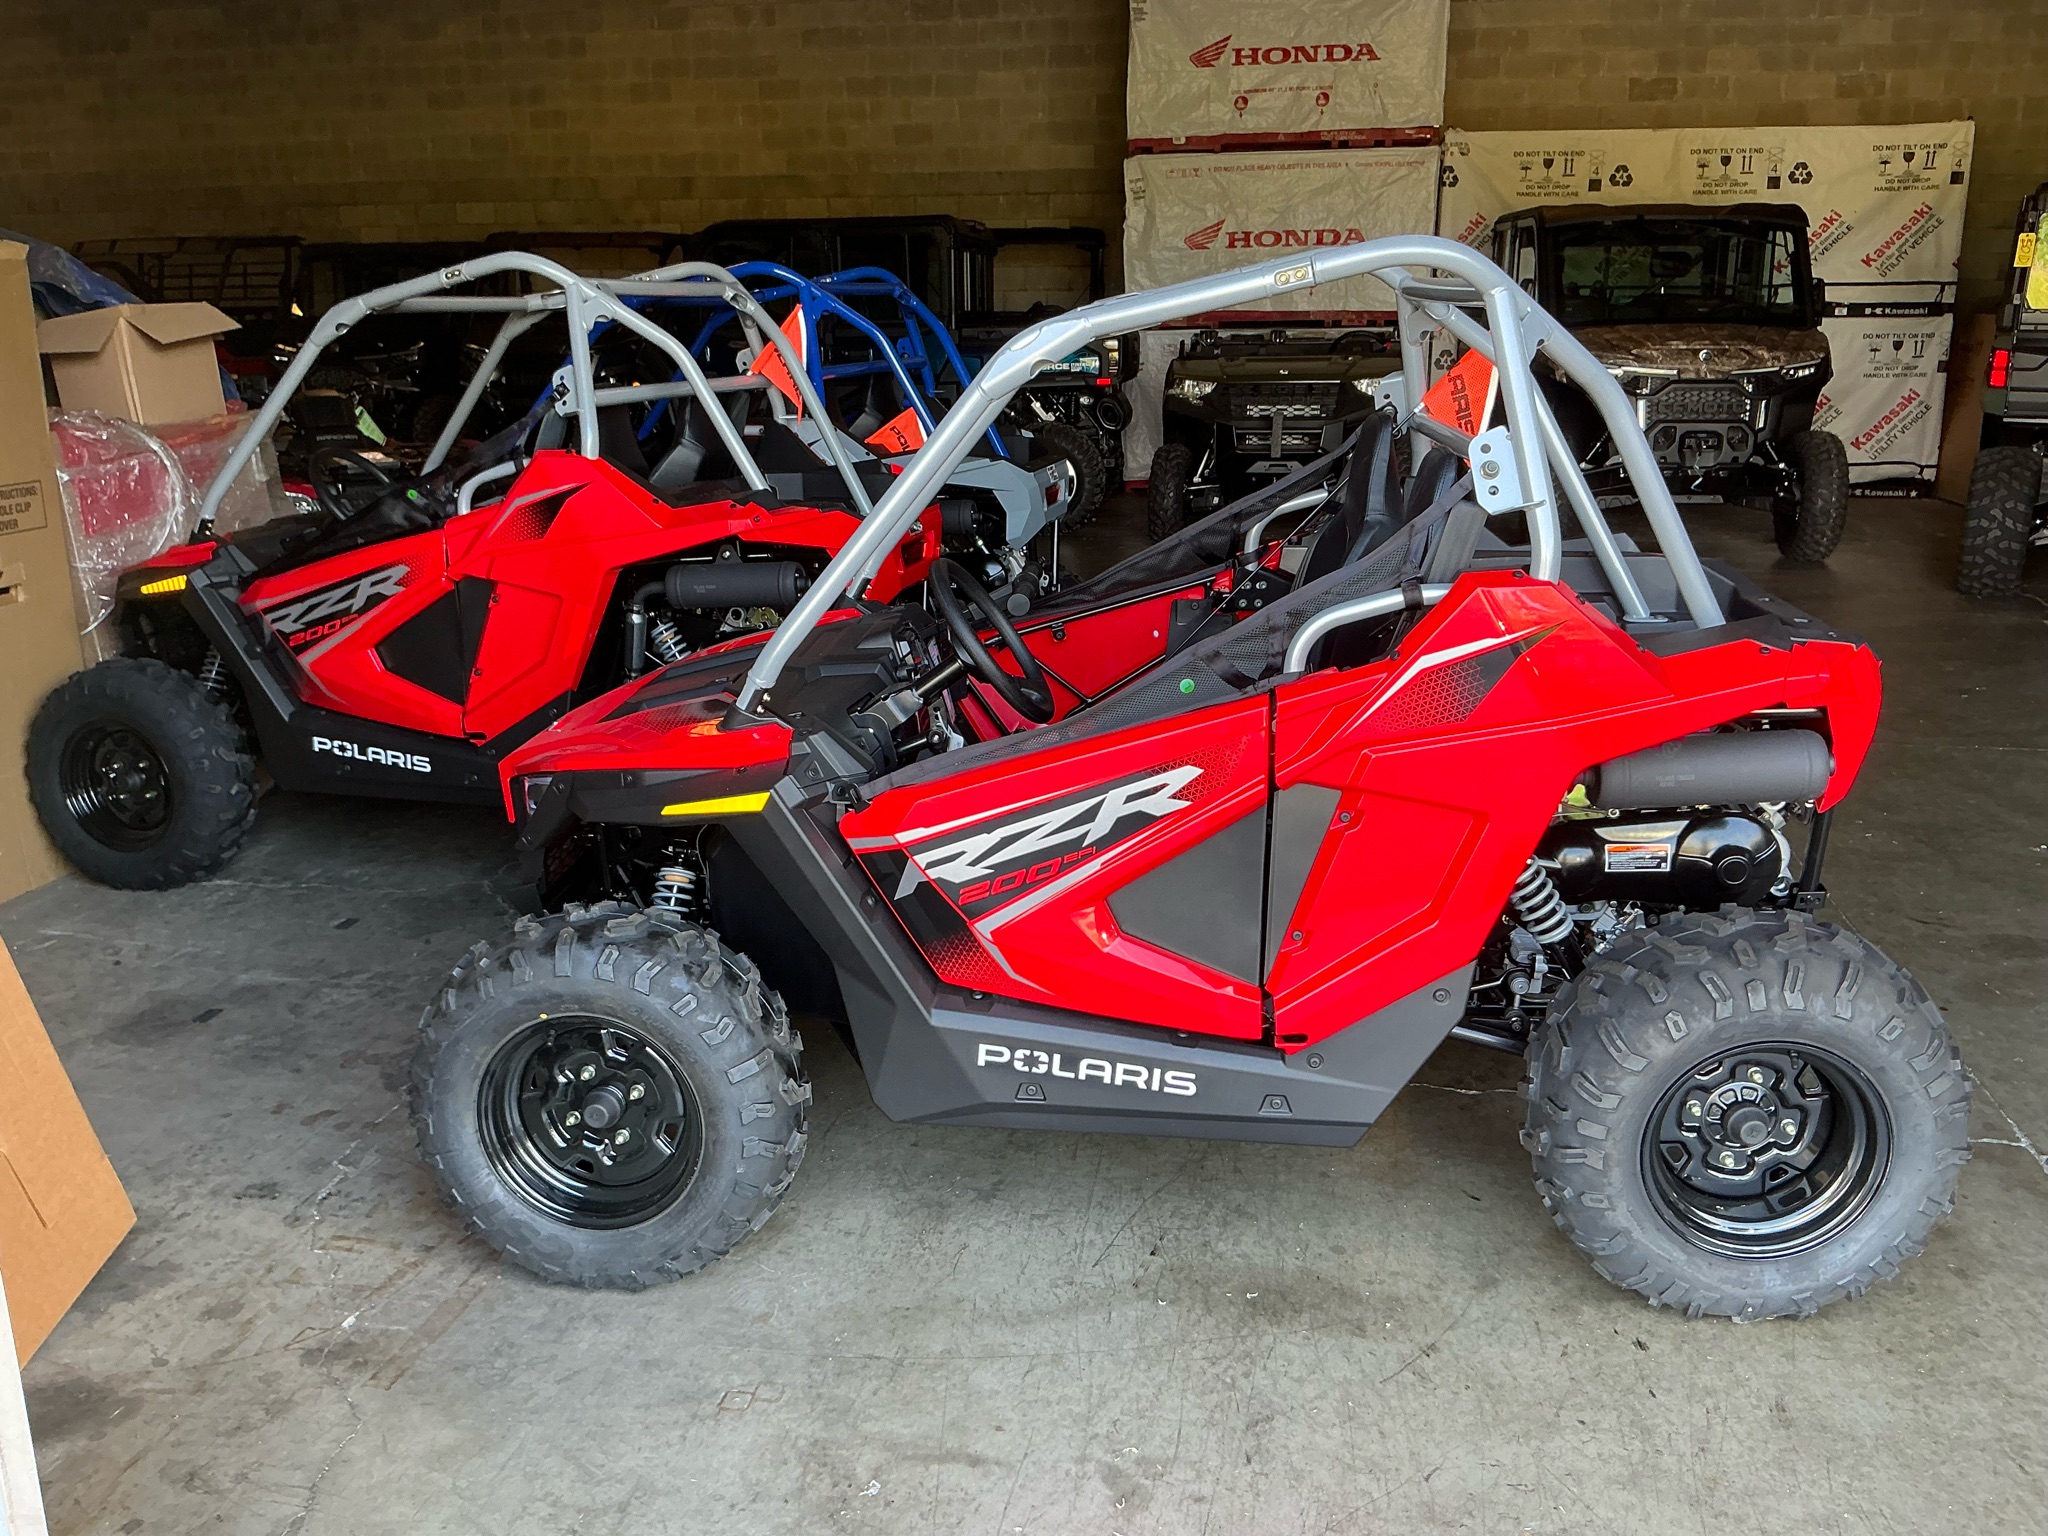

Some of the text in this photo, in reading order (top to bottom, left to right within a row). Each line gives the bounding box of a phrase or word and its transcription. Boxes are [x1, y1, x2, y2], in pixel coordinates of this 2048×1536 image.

[1231, 43, 1381, 66] HONDA
[1225, 229, 1366, 249] HONDA
[1458, 212, 1487, 242] saki
[1808, 209, 1842, 247] asaki
[1818, 223, 1855, 256] VEHICLE
[1860, 201, 1933, 268] Kawasaki
[1879, 216, 1944, 278] UTILITY VEHICLE
[1885, 307, 1928, 315] Kawasaki
[1447, 373, 1475, 435] ARIS
[1658, 401, 1746, 413] CFMOTO
[1850, 388, 1921, 451] Kawasaki
[1868, 403, 1933, 461] UTILITY VEHICLE
[0, 485, 39, 500] RUCTIONS:
[0, 501, 31, 517] OLE CLIP
[1864, 489, 1907, 497] Kawasaki
[263, 564, 411, 646] RZR
[289, 619, 340, 647] 200
[312, 736, 432, 773] POLARIS
[893, 765, 1205, 901] RZR
[958, 846, 1097, 906] 200 EFI
[977, 1043, 1198, 1097] POLARIS
